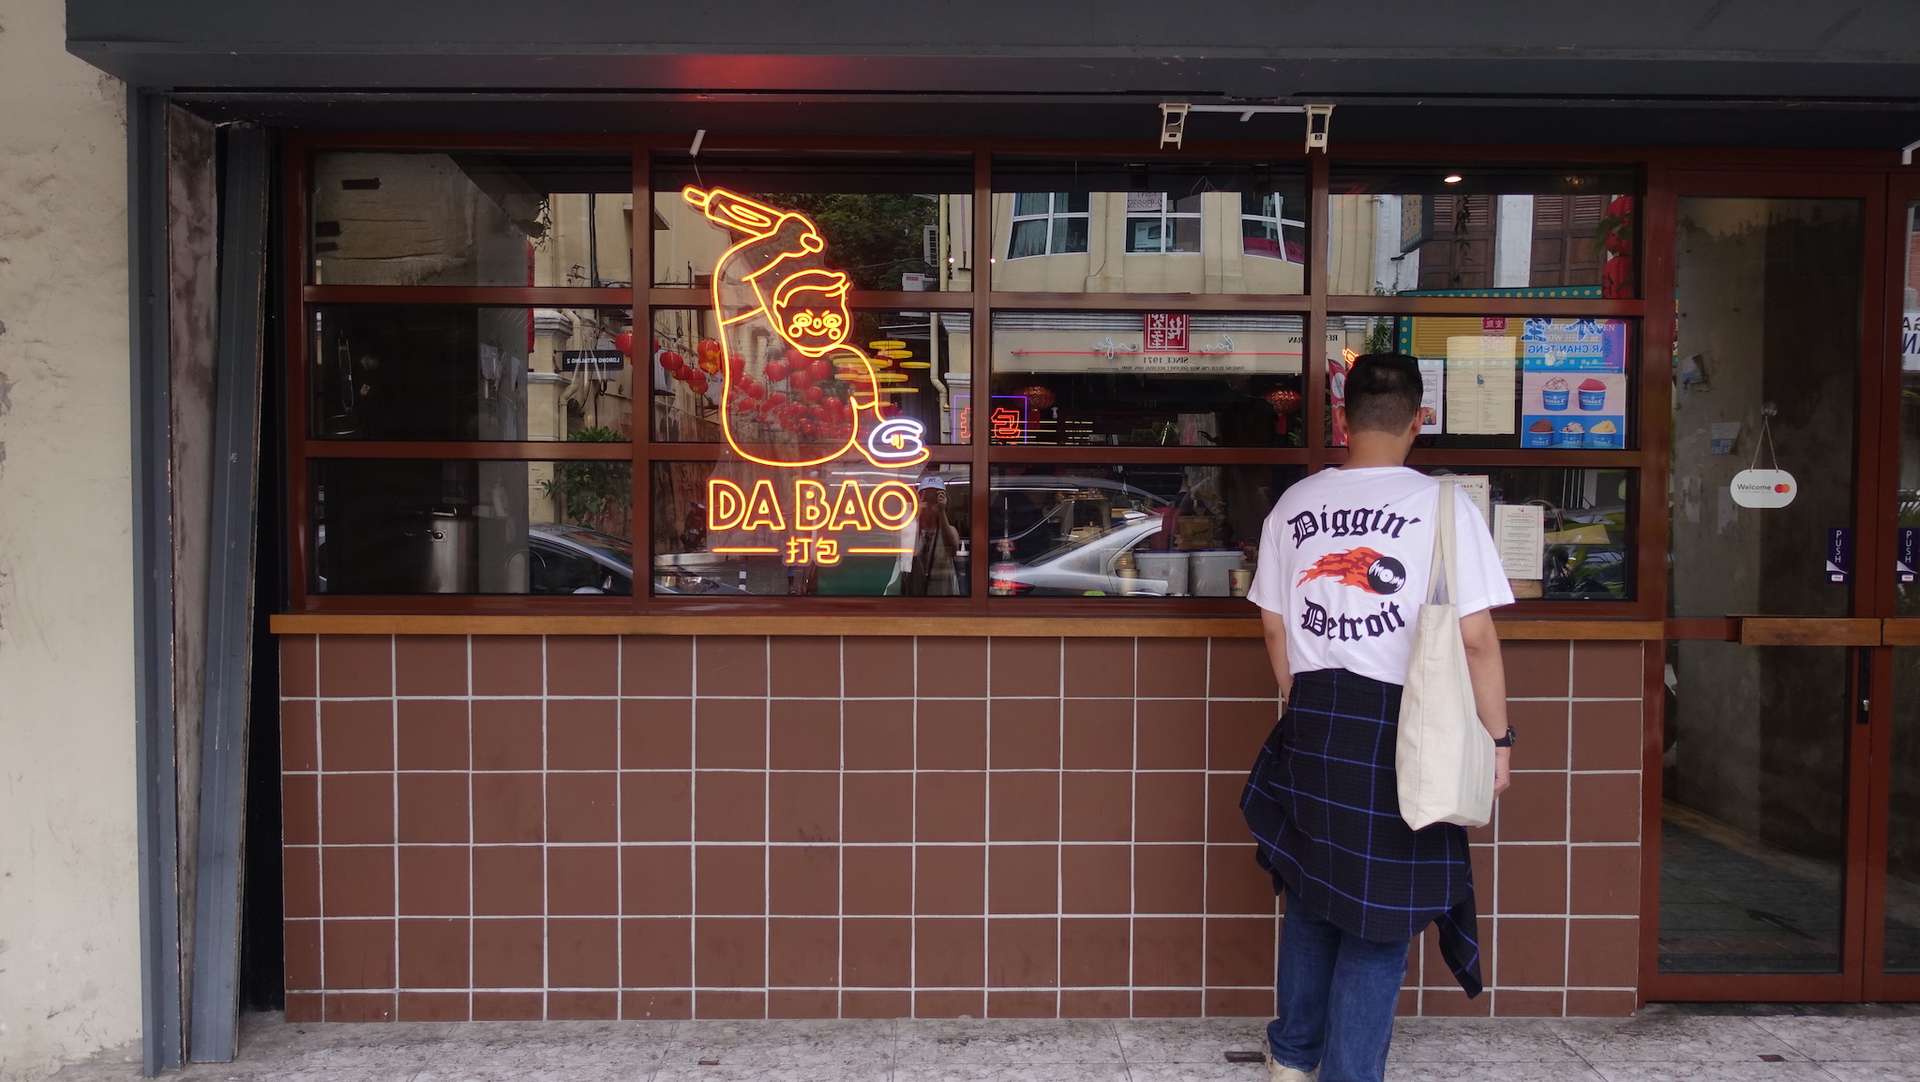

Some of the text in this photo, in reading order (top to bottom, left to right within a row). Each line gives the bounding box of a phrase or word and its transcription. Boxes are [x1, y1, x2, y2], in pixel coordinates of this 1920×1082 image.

[708, 479, 919, 531] DA BAO
[1736, 483, 1772, 491] Welcome
[1287, 504, 1421, 549] Diggin'
[1834, 529, 1842, 563] PUSH
[785, 536, 840, 564] 打包
[1301, 596, 1405, 641] Detroit
